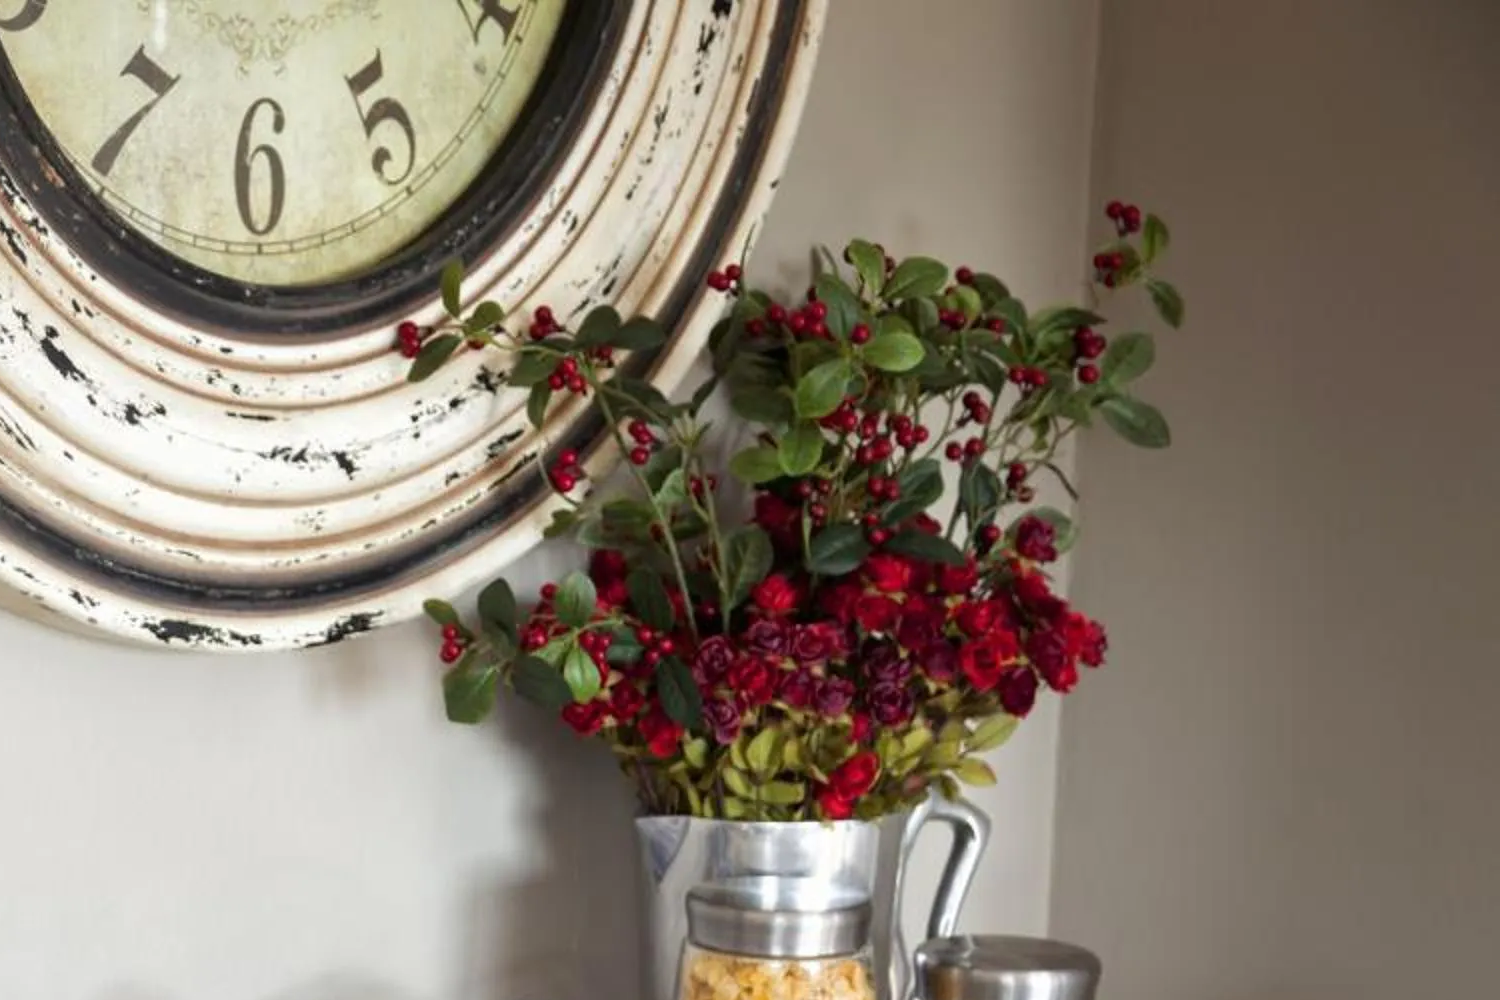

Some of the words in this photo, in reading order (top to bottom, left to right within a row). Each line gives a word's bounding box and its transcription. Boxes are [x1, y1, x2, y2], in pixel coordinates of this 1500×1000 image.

[91, 44, 182, 178] 7
[234, 98, 286, 236] 6
[343, 47, 417, 185] 5
